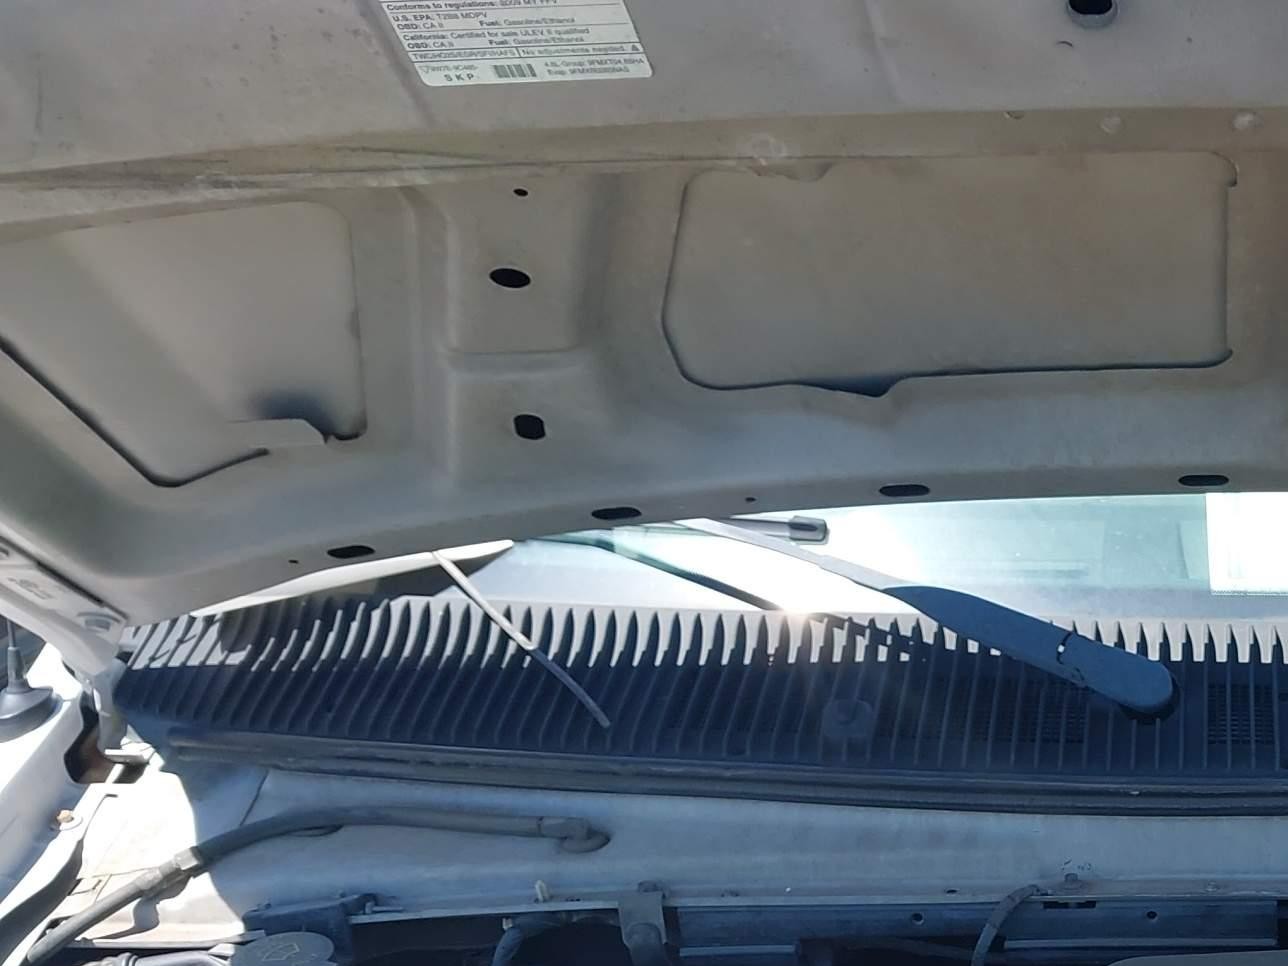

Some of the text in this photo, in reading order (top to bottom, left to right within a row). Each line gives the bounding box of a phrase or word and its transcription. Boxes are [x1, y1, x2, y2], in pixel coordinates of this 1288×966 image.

[387, 2, 431, 11] Conforms
[432, 1, 443, 10] to
[403, 33, 450, 41] California:
[455, 73, 465, 81] K
